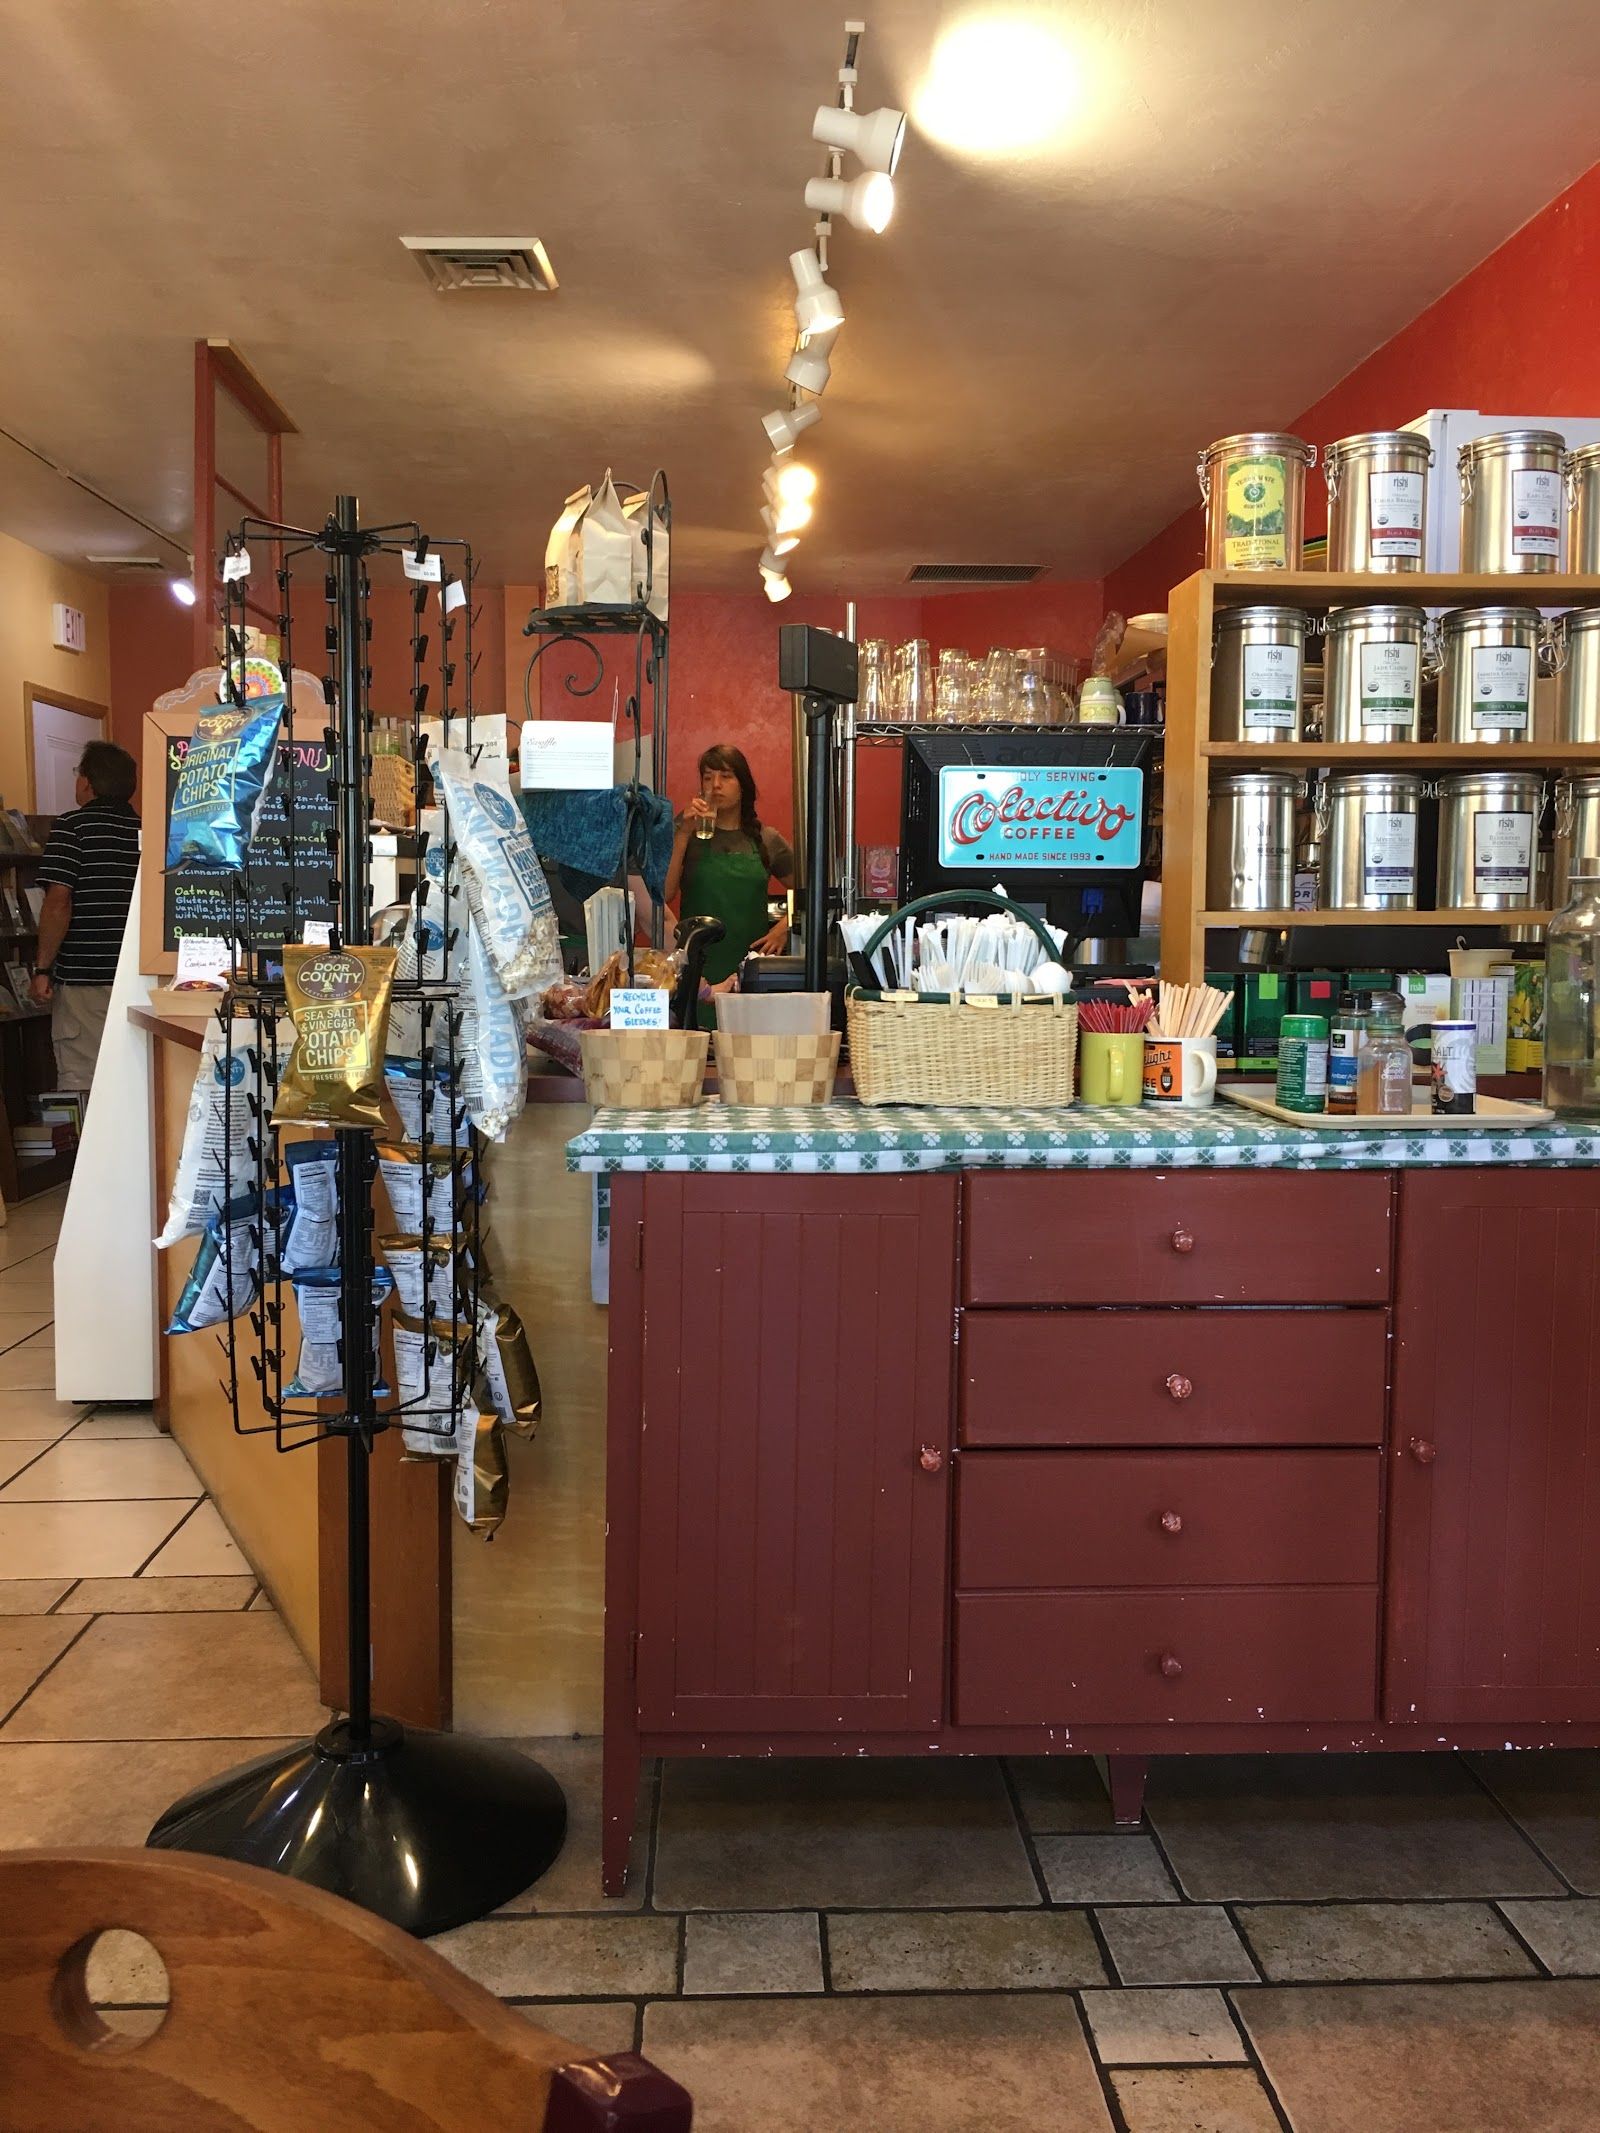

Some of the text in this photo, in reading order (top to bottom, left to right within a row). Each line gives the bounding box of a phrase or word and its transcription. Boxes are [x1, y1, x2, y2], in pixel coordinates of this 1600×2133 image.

[1393, 476, 1409, 488] rishi
[1535, 475, 1550, 487] rishi
[1267, 649, 1283, 660] rishi
[1384, 647, 1400, 659] rishi
[1495, 651, 1512, 663] rishi
[181, 745, 234, 770] ORIGINAL
[179, 763, 229, 789] POTATO
[1046, 771, 1096, 782] SERVING
[182, 779, 220, 805] CHIPS
[951, 785, 1136, 846] Colectivo
[1388, 817, 1403, 829] rishi
[1498, 818, 1515, 831] rishi
[1003, 827, 1076, 840] COFFEE
[273, 846, 333, 857] alondmil
[989, 852, 1091, 861] HAND MADE SINCE 1993
[275, 858, 305, 867] male
[175, 896, 228, 906] Glutenfre
[264, 896, 329, 907] almodmilk,
[202, 912, 231, 923] maple
[234, 914, 266, 925] syup
[314, 962, 351, 972] DOOR
[300, 971, 361, 984] COUNTY
[304, 987, 353, 998] KETTLE CHIPS
[622, 992, 657, 1001] RECYCLE
[303, 1008, 353, 1022] SEA SALT
[300, 1018, 357, 1033] & VINEGAR
[301, 1028, 361, 1049] POTATO
[305, 1046, 357, 1067] CHIPS
[1144, 1049, 1172, 1066] light
[1381, 1073, 1406, 1081] Organic
